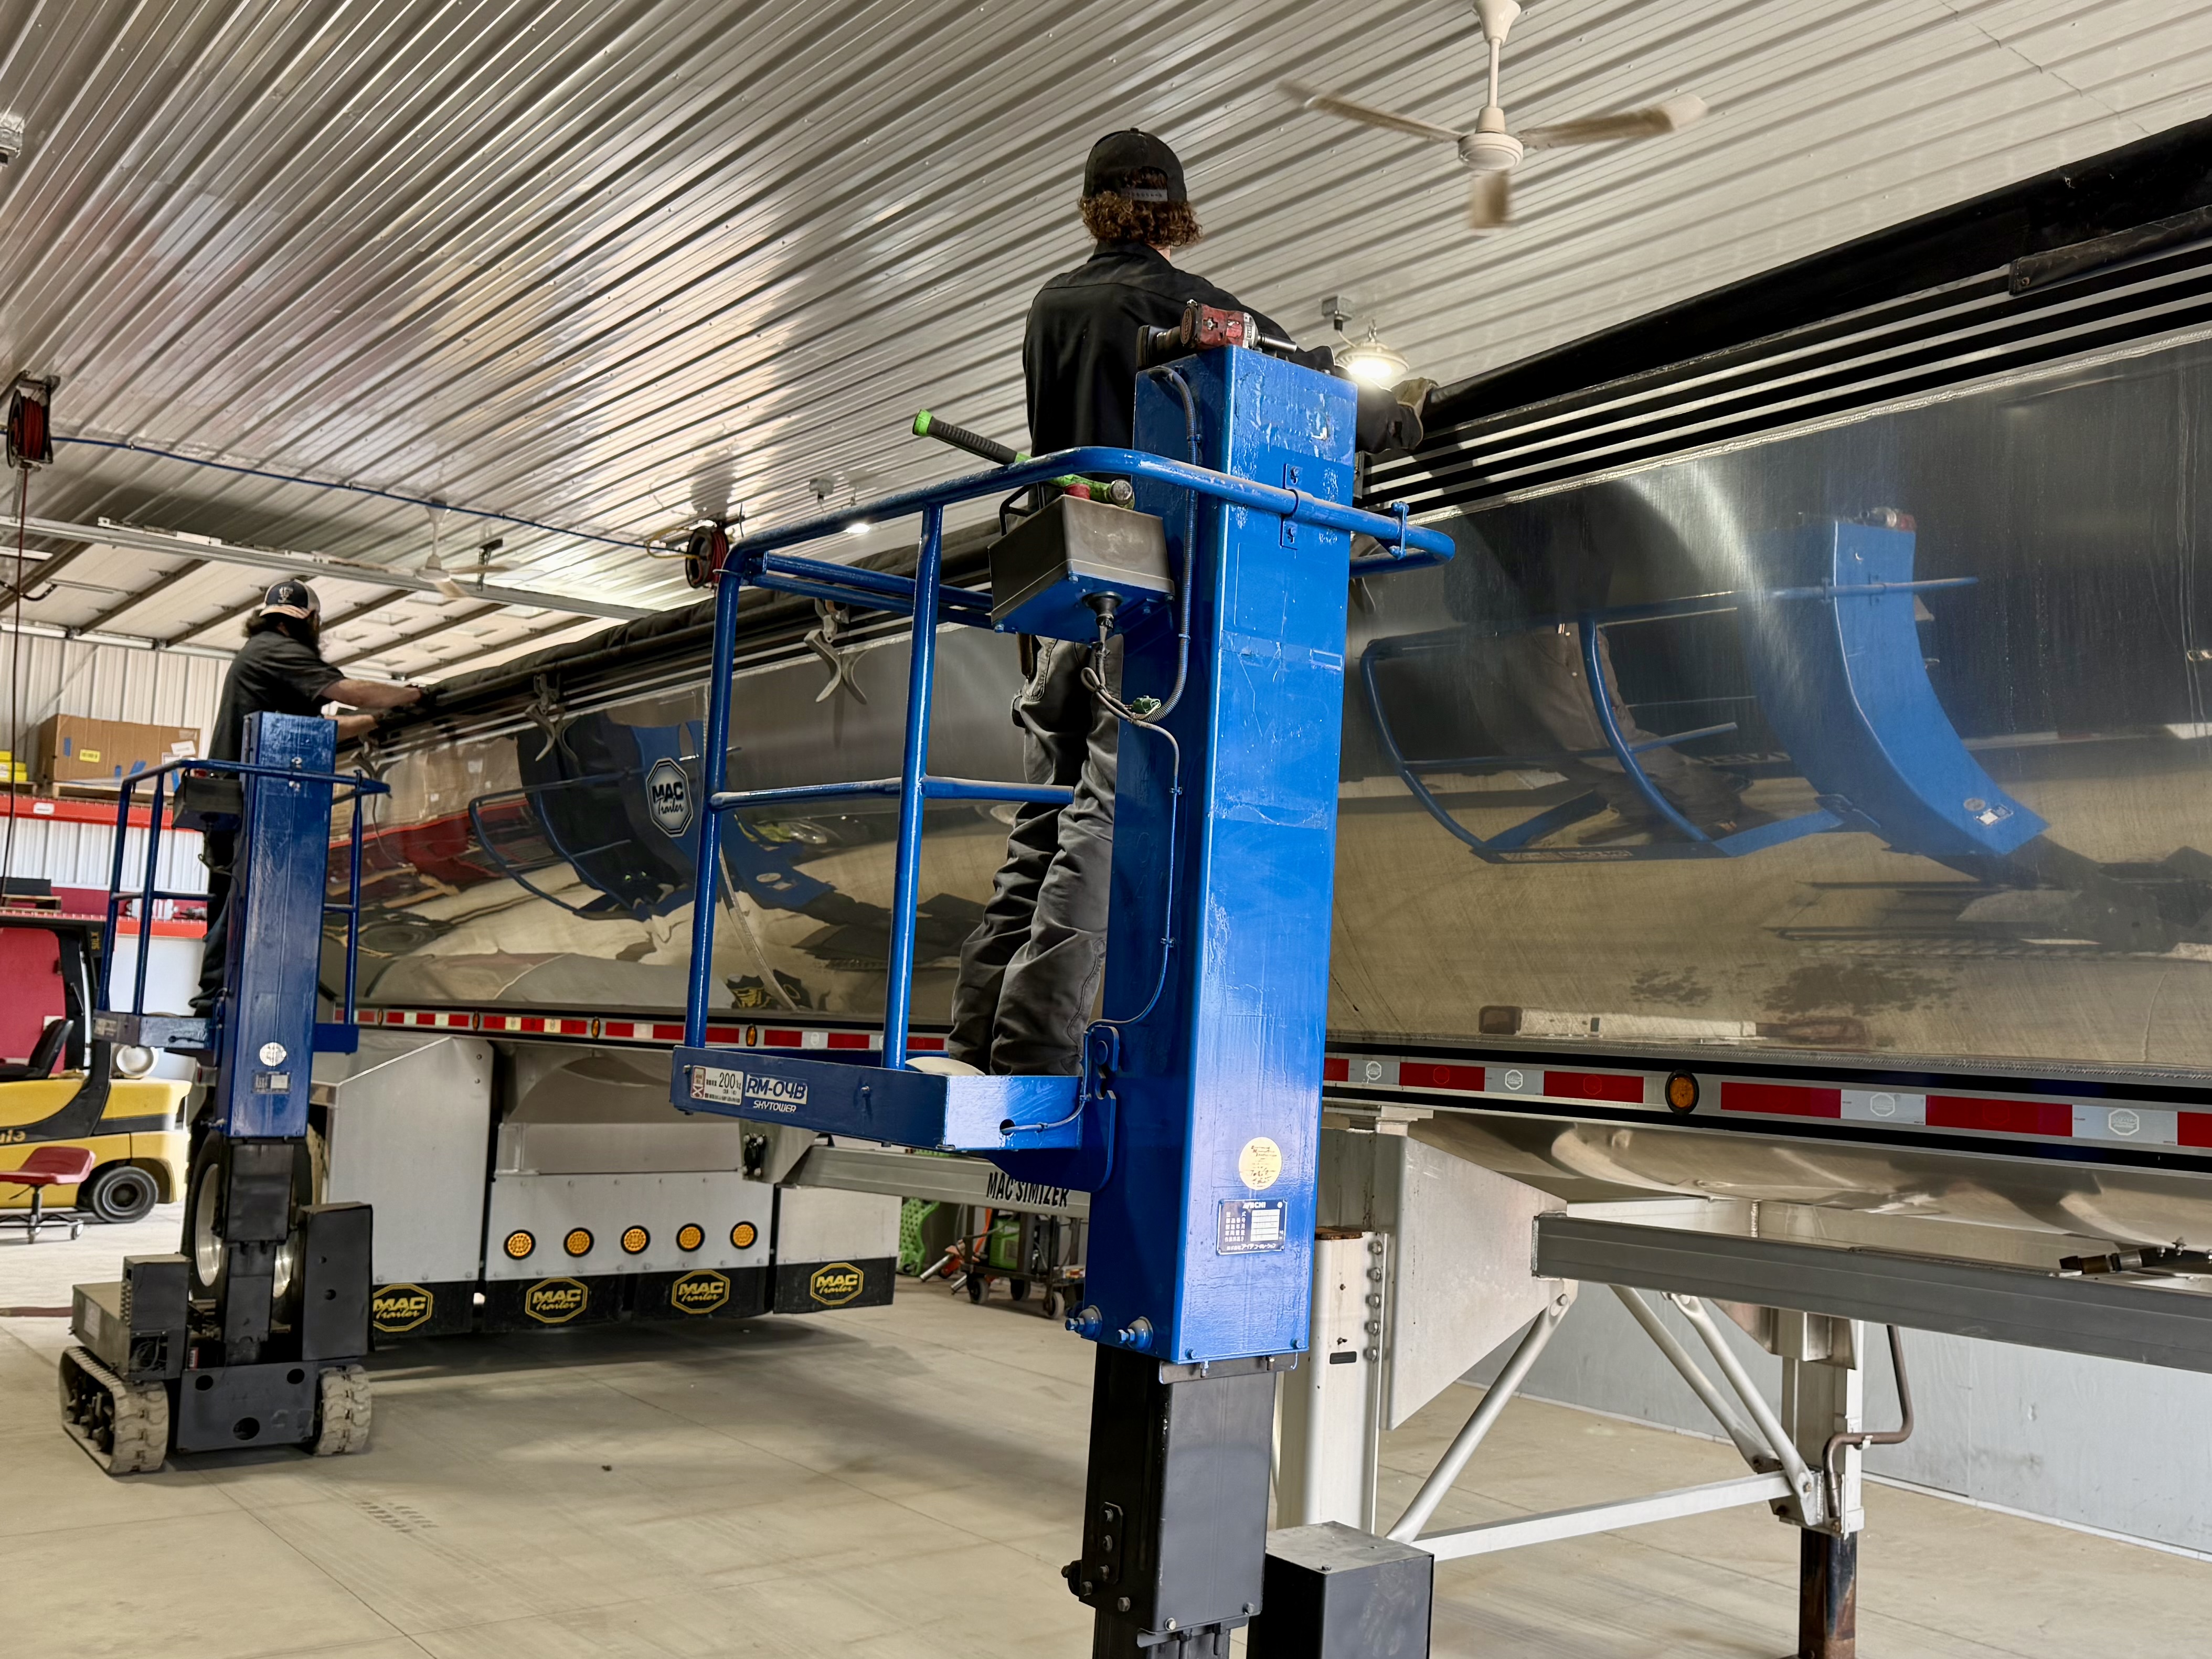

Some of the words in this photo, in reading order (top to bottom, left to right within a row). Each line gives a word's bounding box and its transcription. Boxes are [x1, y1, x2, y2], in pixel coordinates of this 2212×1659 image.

[652, 782, 684, 804] MAC
[656, 797, 684, 815] Trailer
[719, 1072, 736, 1089] 200
[746, 1077, 807, 1100] RM-04B
[753, 1100, 796, 1112] SKYTOWER
[816, 1274, 858, 1288] MAC
[678, 1282, 724, 1295] MAC
[819, 1284, 853, 1294] Trailer
[533, 1289, 581, 1304] MAC
[681, 1290, 720, 1302] Trailer
[373, 1296, 426, 1312] MAC
[536, 1298, 577, 1311] Trailer
[376, 1306, 420, 1319] Trailer
